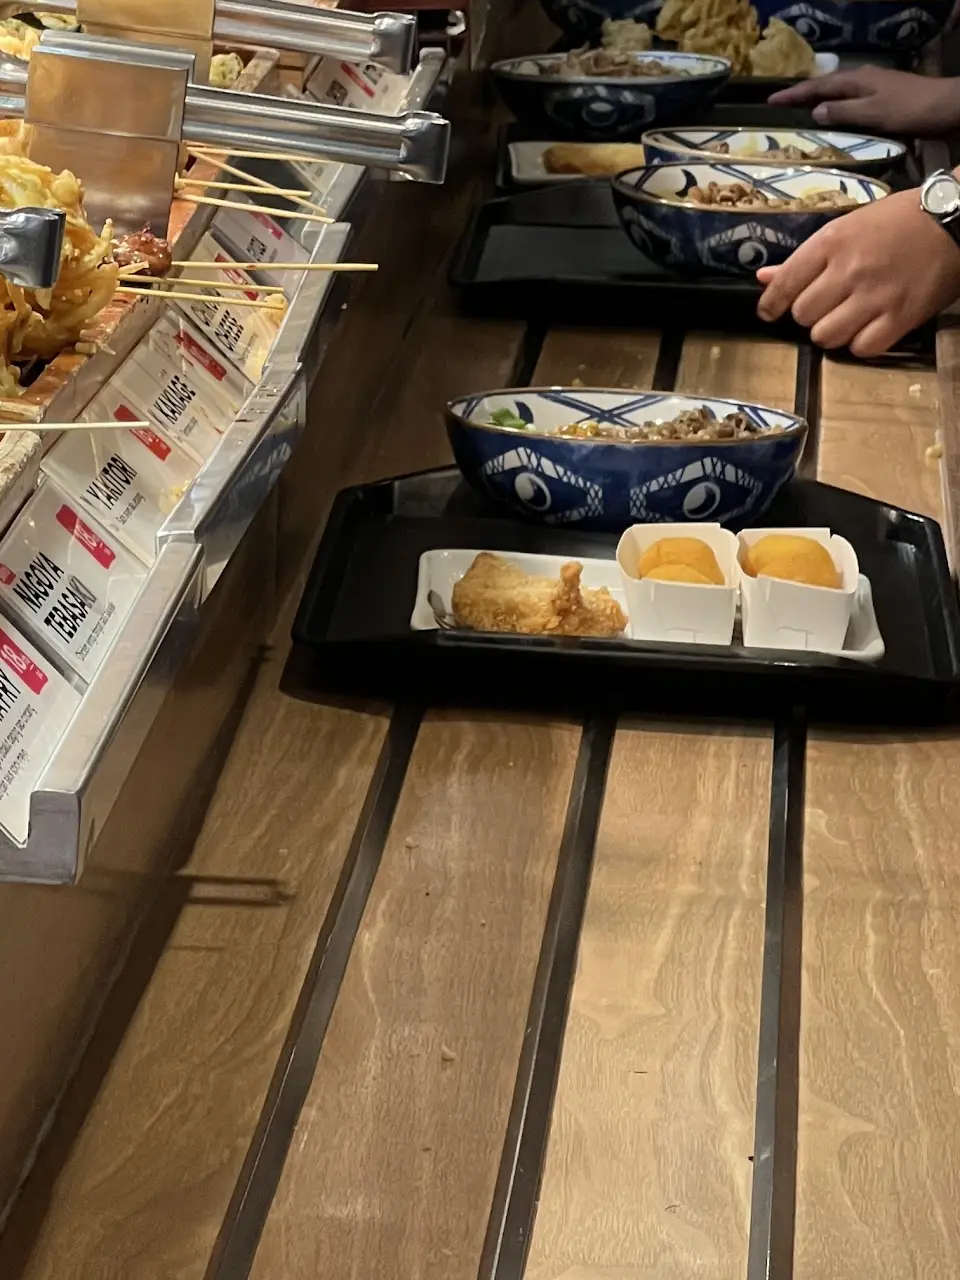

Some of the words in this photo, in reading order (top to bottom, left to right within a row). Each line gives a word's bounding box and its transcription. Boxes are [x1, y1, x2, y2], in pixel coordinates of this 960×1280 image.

[153, 375, 196, 424] KAKIAGE
[86, 453, 138, 510] YAKITORI
[13, 552, 64, 613] NAGOYA
[43, 575, 97, 644] TEBASAKI
[0, 643, 28, 674] 18
